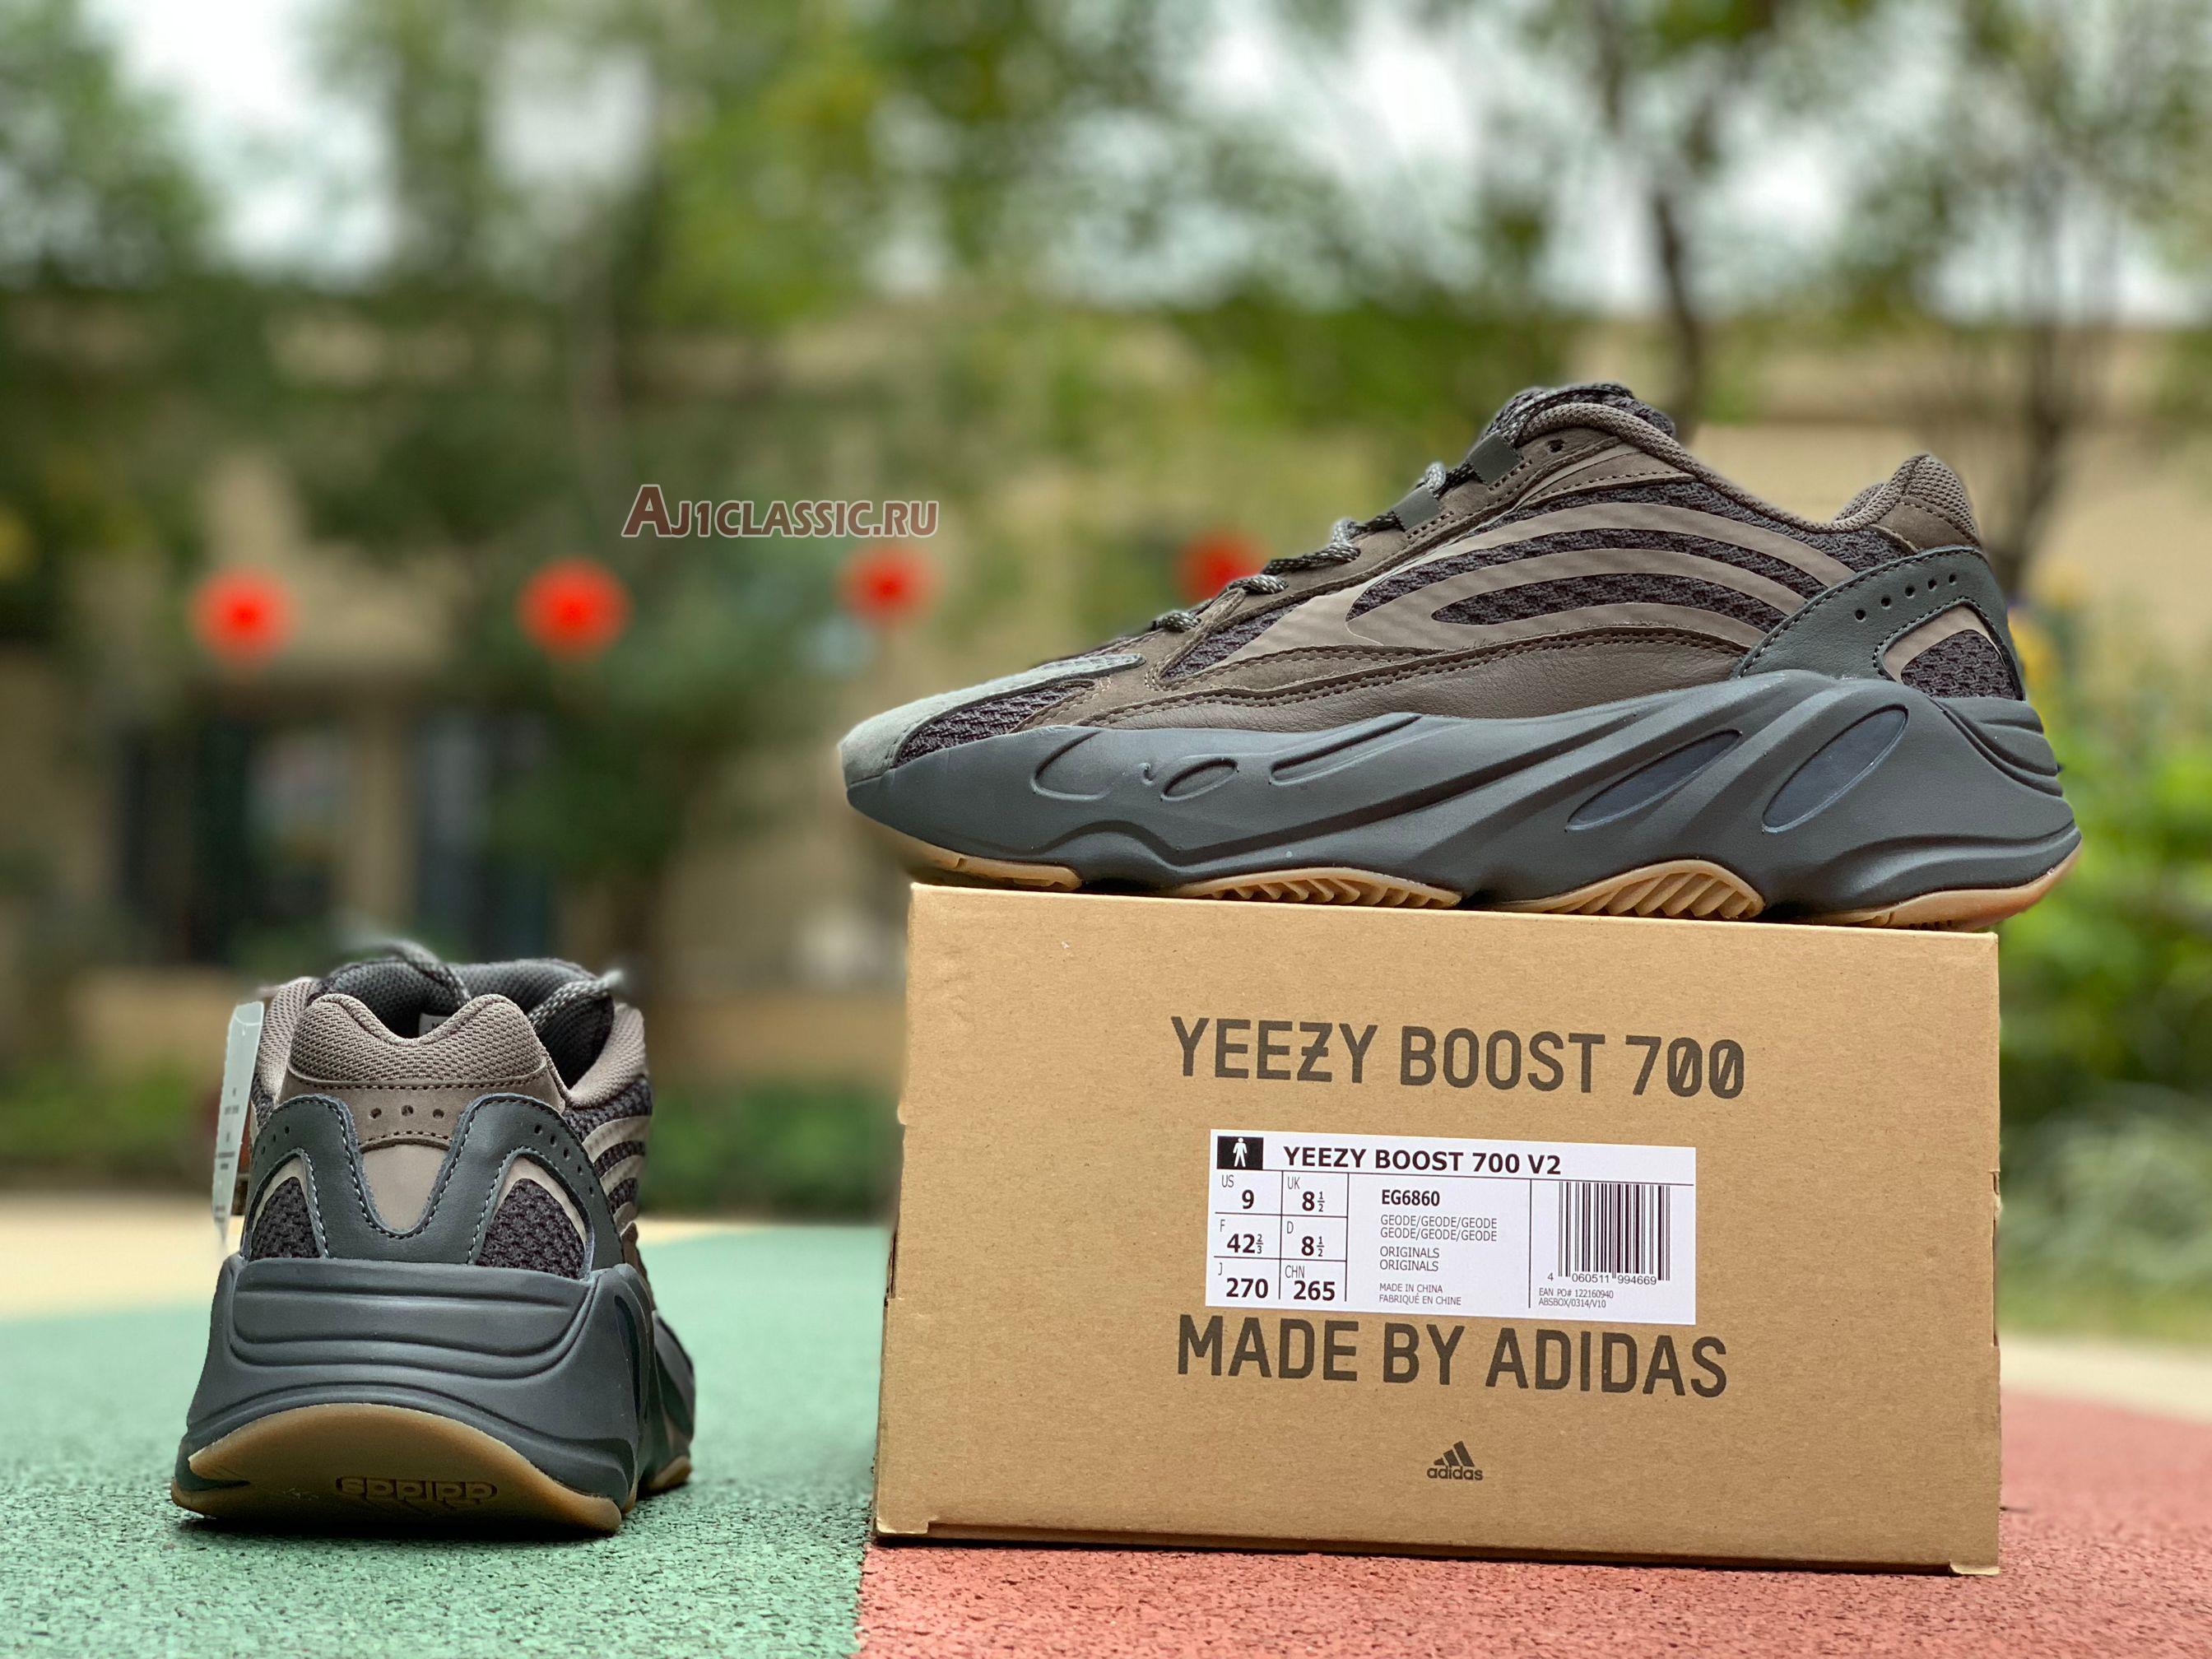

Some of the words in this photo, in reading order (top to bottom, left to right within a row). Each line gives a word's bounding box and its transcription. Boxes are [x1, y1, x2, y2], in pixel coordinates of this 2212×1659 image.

[1171, 1016, 1378, 1084] YEEZY
[1400, 1026, 1605, 1093] BOOST
[1625, 1034, 1745, 1099] 700
[1283, 1146, 1367, 1169] YEEZY
[1375, 1149, 1464, 1172] BOOST
[1472, 1152, 1520, 1174] 700
[1528, 1155, 1561, 1175] V2
[1221, 1174, 1234, 1187] US
[1287, 1176, 1300, 1190] UK
[1242, 1189, 1255, 1210] 9
[1382, 1189, 1440, 1206] EG6860
[1220, 1219, 1225, 1233] F
[1286, 1220, 1294, 1234] D
[1380, 1215, 1498, 1229] GEODE/GEODE/GEODE
[1380, 1227, 1498, 1242] GEODE/GEODE/GEODE
[1379, 1246, 1440, 1259] ORIGINALS
[1218, 1262, 1223, 1276] J
[1285, 1265, 1305, 1279] CHN
[1379, 1259, 1439, 1272] ORIGINALS
[1547, 1272, 1554, 1282] 4
[1572, 1272, 1610, 1284] 060511
[1617, 1275, 1657, 1286] 994669
[1225, 1277, 1269, 1299] 270
[1293, 1280, 1336, 1302] 265
[1379, 1283, 1402, 1292] MADE
[1405, 1284, 1415, 1293] IN
[1416, 1285, 1443, 1294] CHINA
[1539, 1287, 1554, 1297] EAN
[1378, 1293, 1420, 1305] FABRIQUÉ
[1422, 1295, 1434, 1304] EN
[1435, 1296, 1462, 1306] CHINE
[1178, 1313, 1359, 1382] MADE
[1382, 1322, 1465, 1386] BY
[1485, 1327, 1727, 1397] ADIDAS
[1426, 1466, 1484, 1480] adidas
